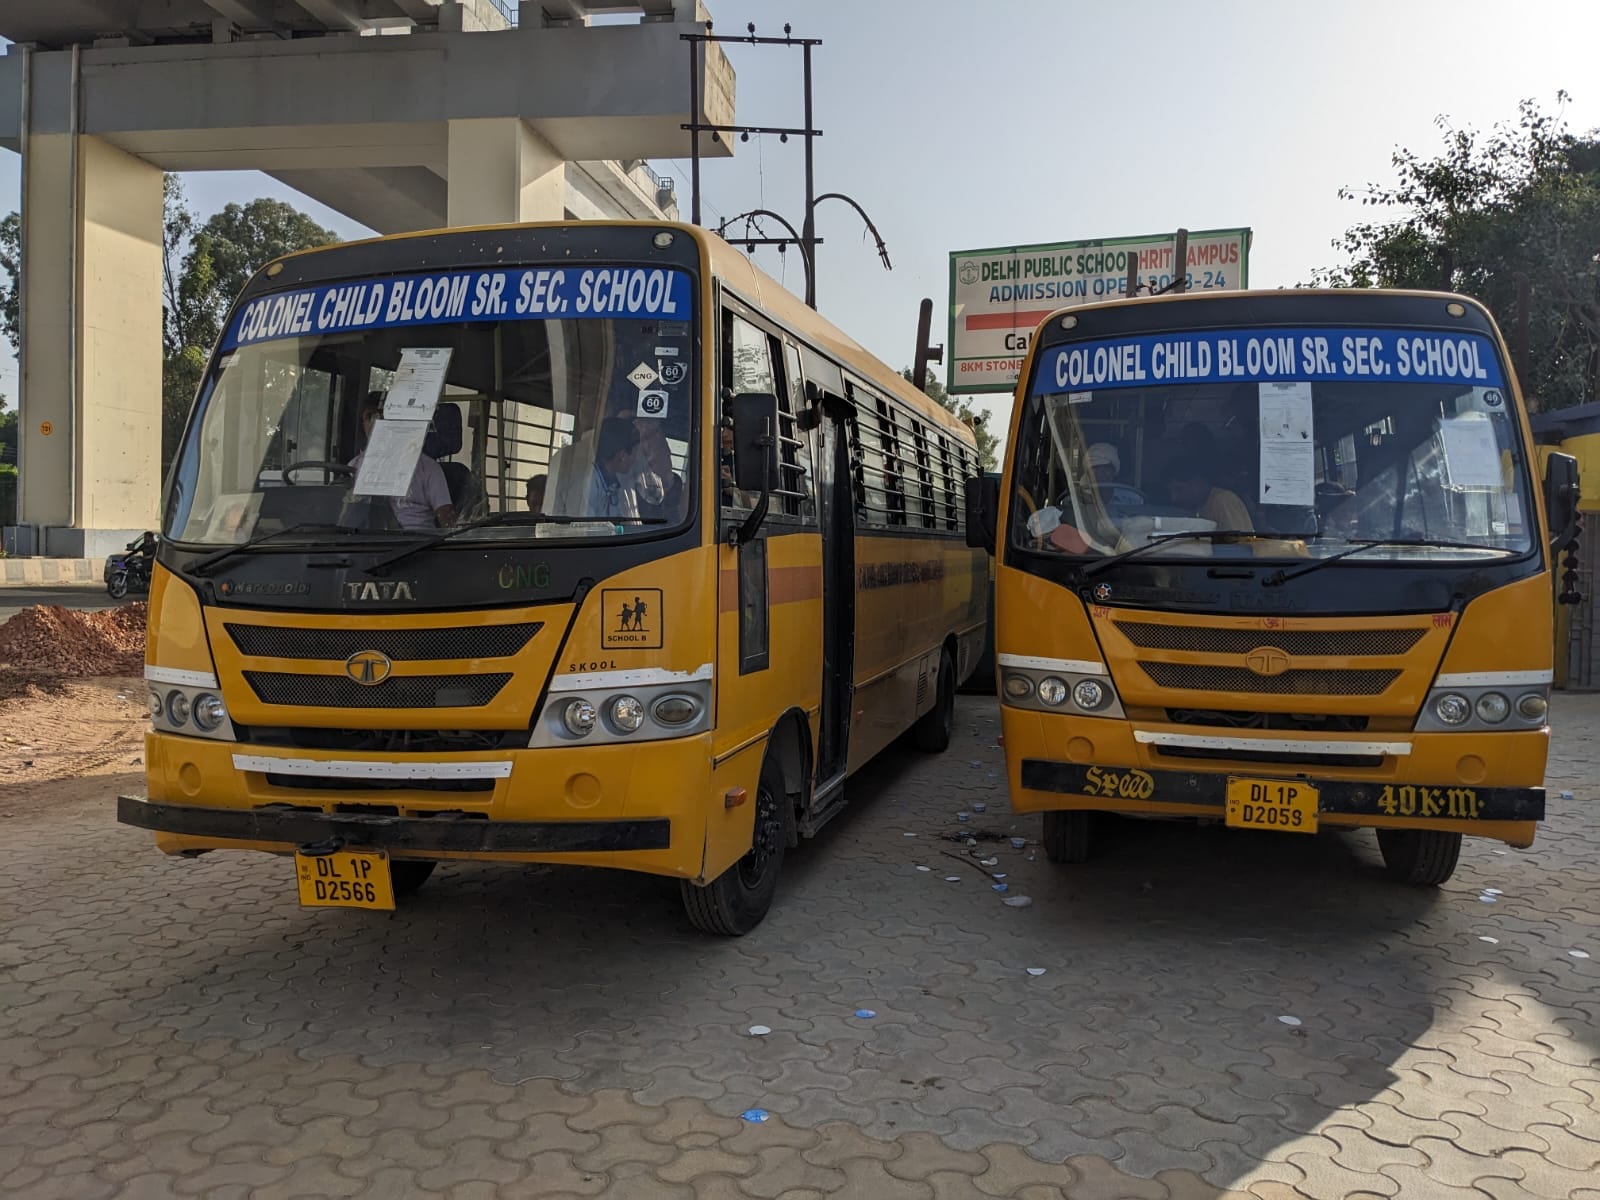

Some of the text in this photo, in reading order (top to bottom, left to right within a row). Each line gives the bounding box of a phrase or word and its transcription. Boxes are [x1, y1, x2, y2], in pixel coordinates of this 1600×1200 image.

[981, 259, 1020, 281] DELHI
[1024, 255, 1072, 278] PUBLIC
[1077, 251, 1127, 275] SCHOO
[1186, 242, 1239, 267] AMPUS
[989, 279, 1087, 302] ADMISSION
[237, 269, 677, 343] COLONEL CHILD BLOOM SR. SEC. SCHOOL
[665, 367, 679, 377] 60
[960, 362, 983, 373] 8KM
[1055, 336, 1488, 388] COLONEL CHILD BLOOM SR. SEC. SCHOOL
[646, 398, 660, 408] 60
[499, 564, 549, 589] CNG
[347, 581, 413, 600] TATA
[607, 634, 639, 642] SCHOOL
[569, 660, 617, 672] SKOOL
[1251, 783, 1298, 806] DL 1P
[1243, 804, 1303, 827] D2059
[315, 857, 372, 879] DL 1P
[315, 879, 376, 903] D2566
